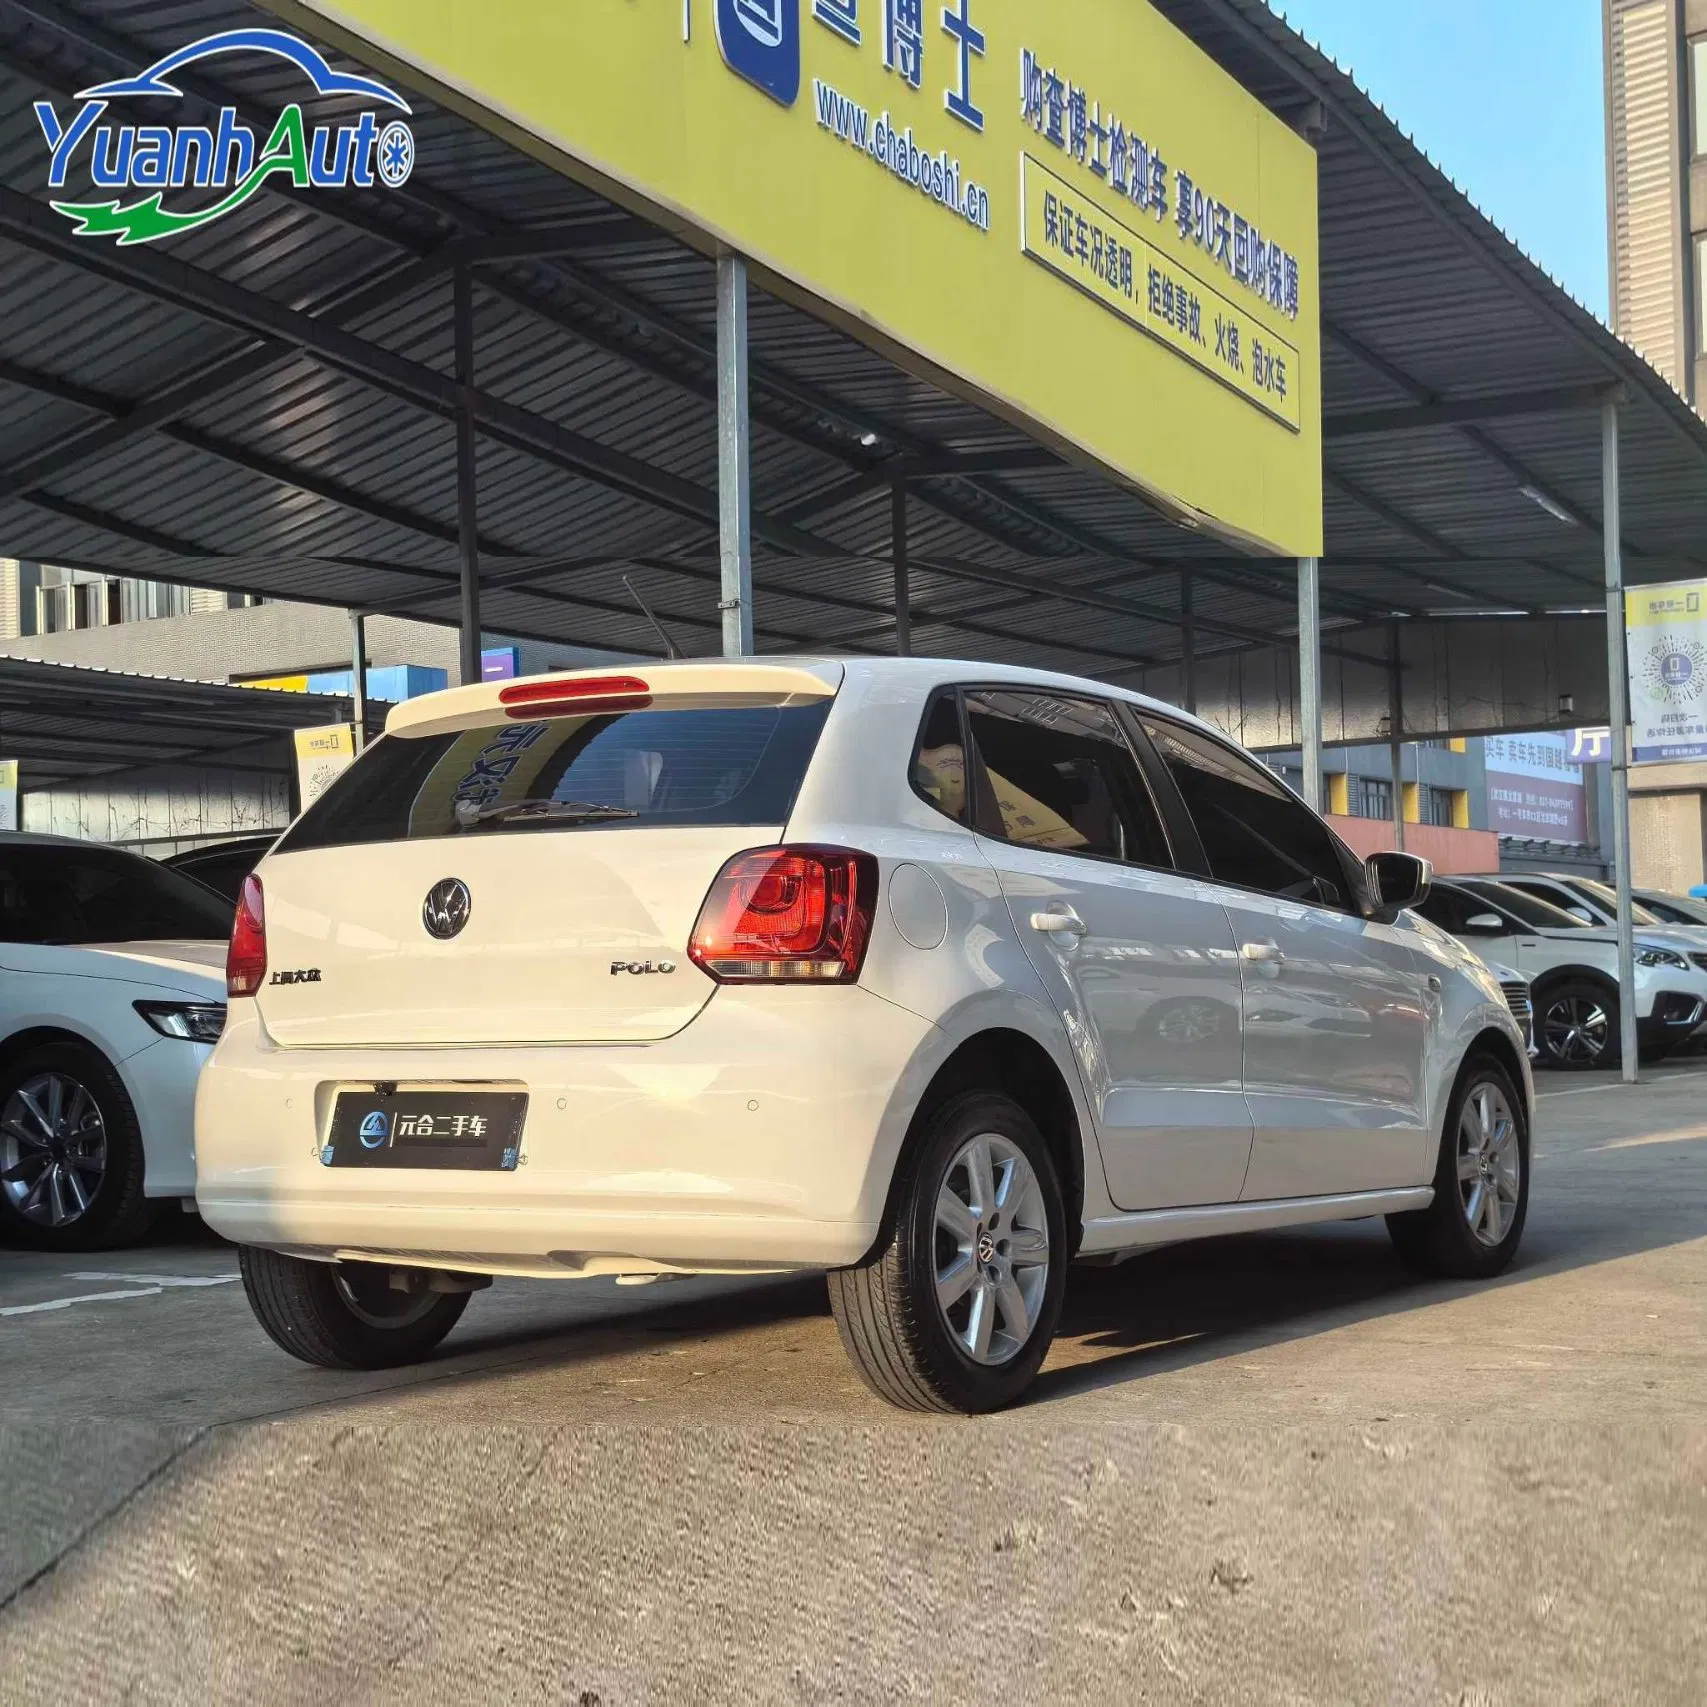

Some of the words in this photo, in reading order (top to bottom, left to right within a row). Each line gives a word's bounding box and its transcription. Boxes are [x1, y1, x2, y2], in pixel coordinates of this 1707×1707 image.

[813, 77, 990, 231] www.chaboshi.cn
[1020, 48, 1169, 223] 购查博士检测车
[1174, 169, 1300, 322] 享90天回购保障
[611, 960, 676, 976] POLO
